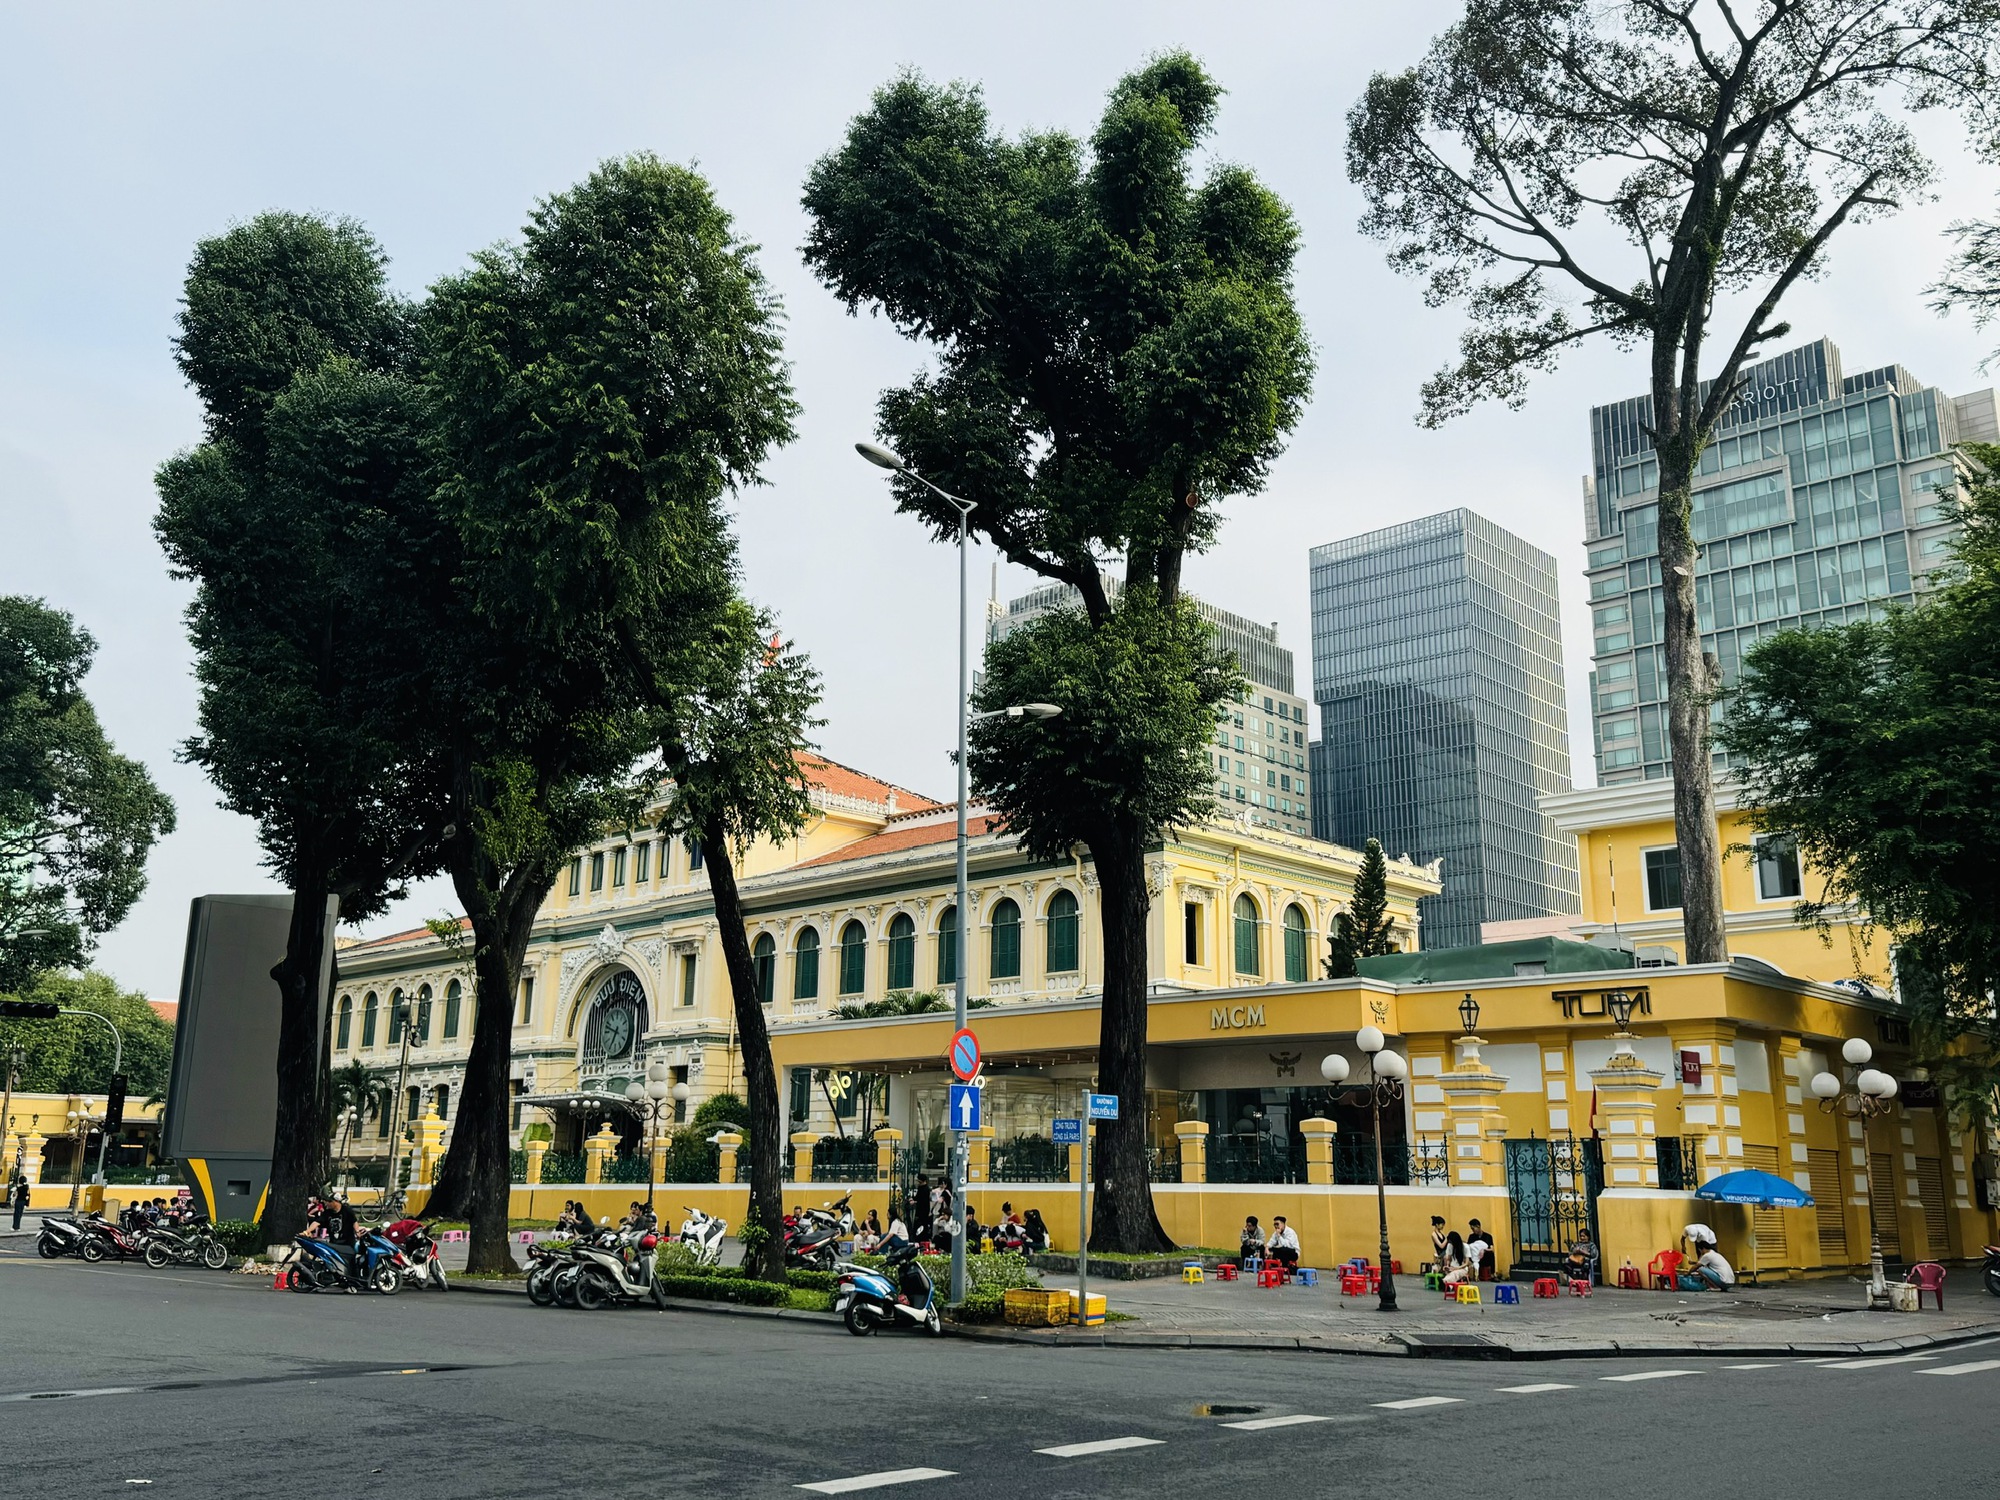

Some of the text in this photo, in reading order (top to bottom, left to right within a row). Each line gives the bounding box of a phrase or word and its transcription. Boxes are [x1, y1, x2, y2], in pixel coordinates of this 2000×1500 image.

[1552, 985, 1652, 1018] TUMI
[1210, 1004, 1266, 1030] MCM
[1726, 1194, 1760, 1203] vinaphone
